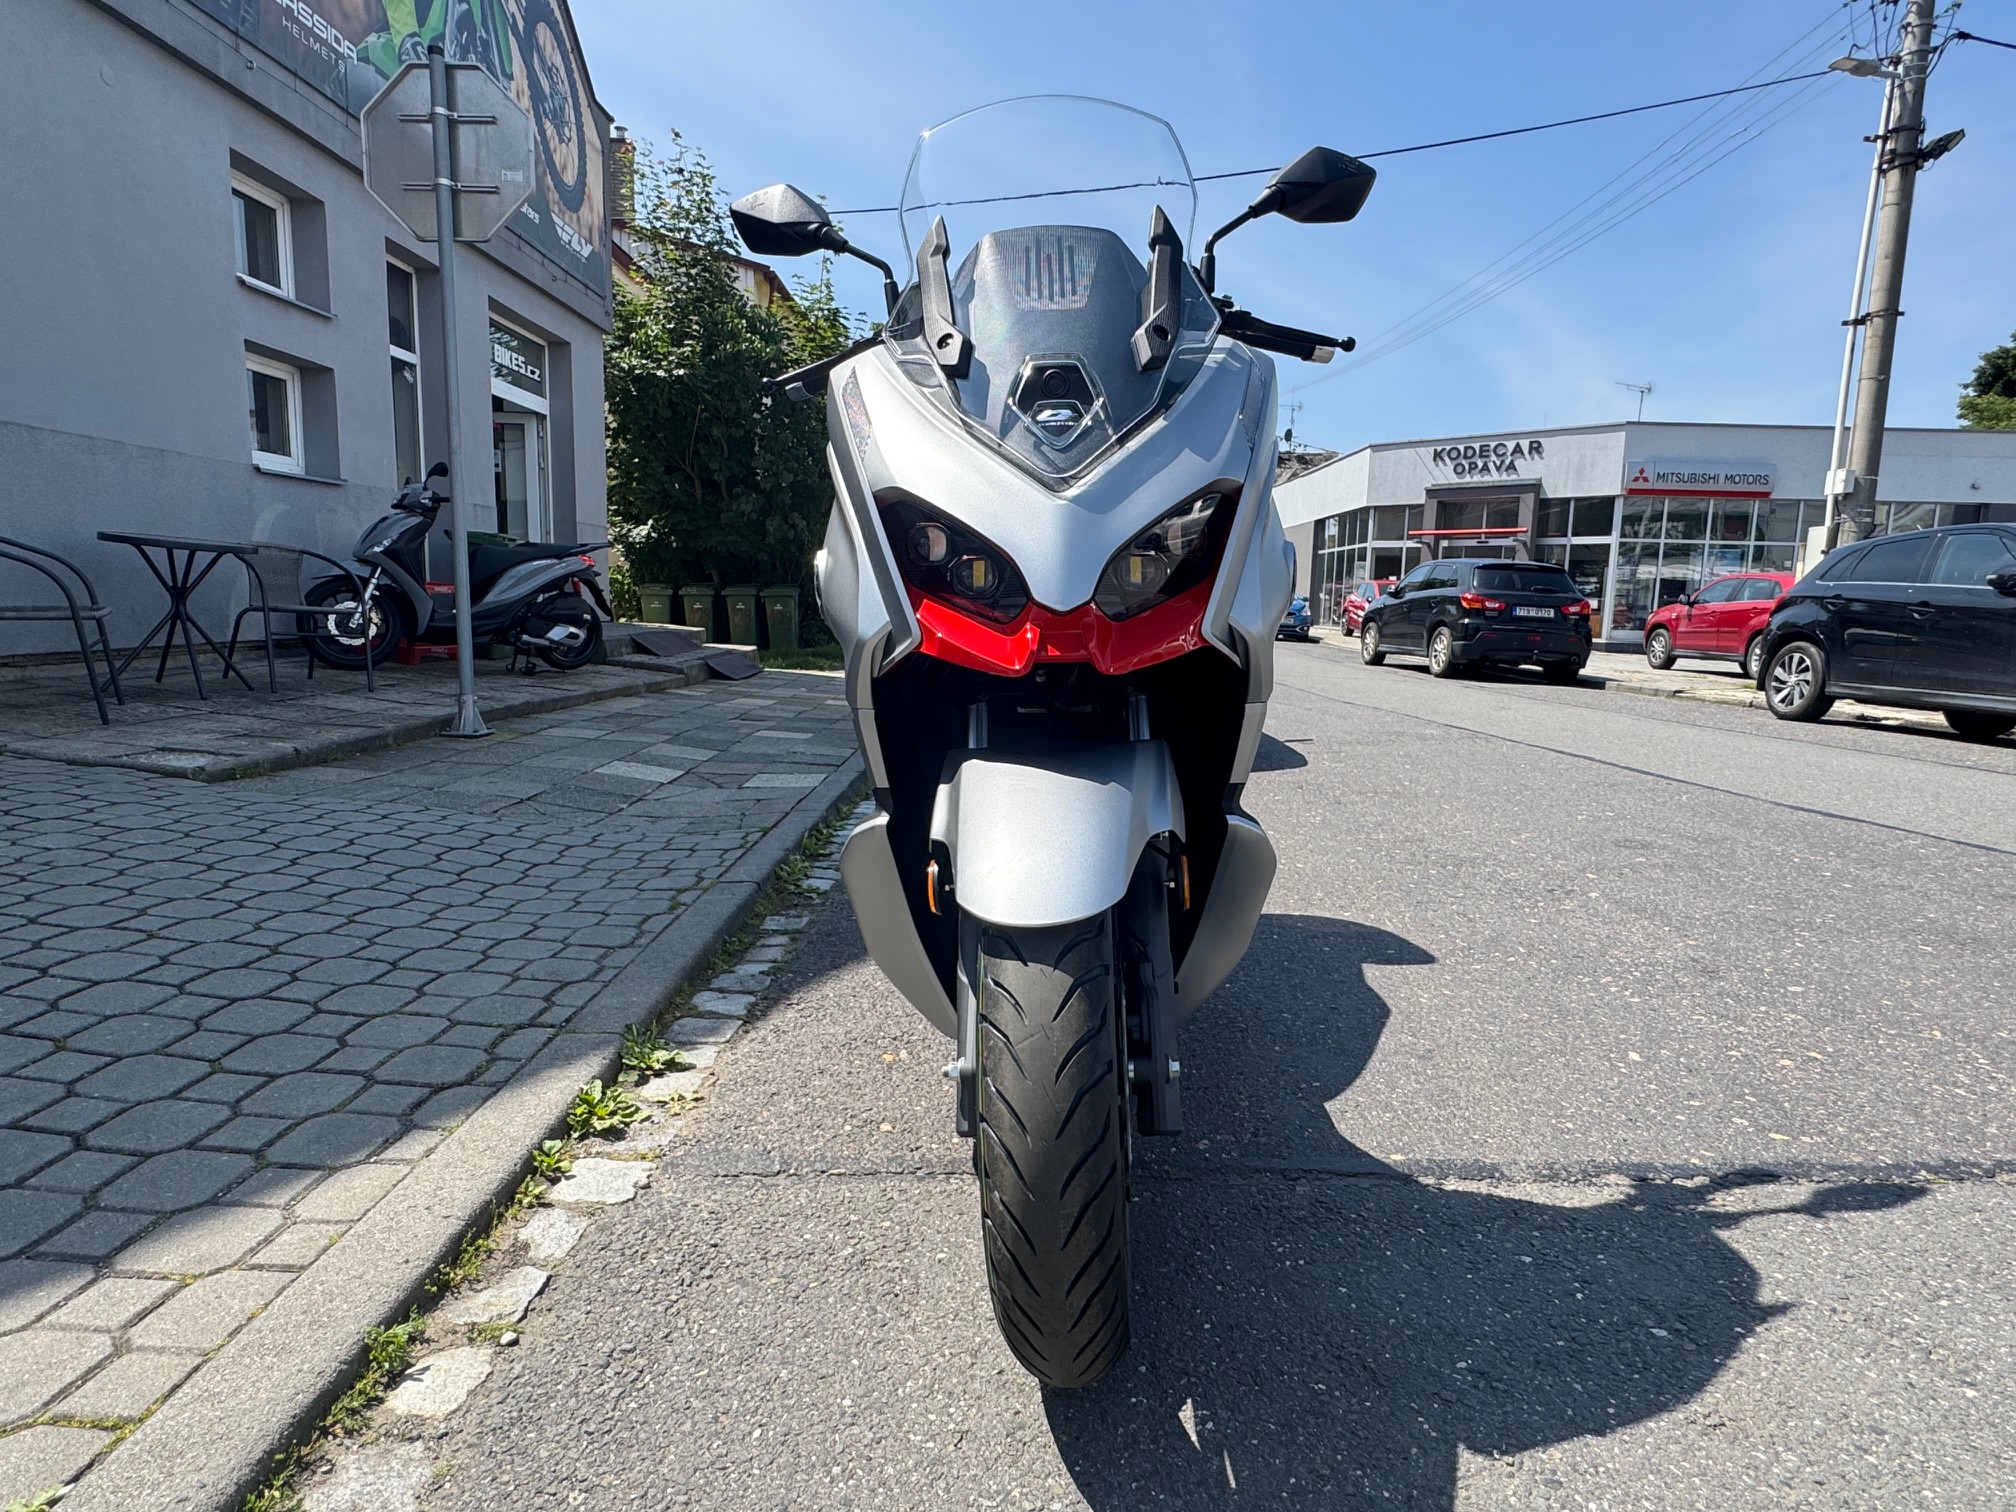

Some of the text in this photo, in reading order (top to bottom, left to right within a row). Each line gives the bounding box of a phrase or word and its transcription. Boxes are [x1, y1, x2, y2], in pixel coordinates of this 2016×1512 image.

[276, 0, 357, 65] ASSIDA
[282, 16, 345, 73] HELMETS
[1433, 440, 1544, 463] KODECAR
[1453, 460, 1518, 475] OPAVA
[1656, 472, 1770, 486] MITSUBISHI MOTORS
